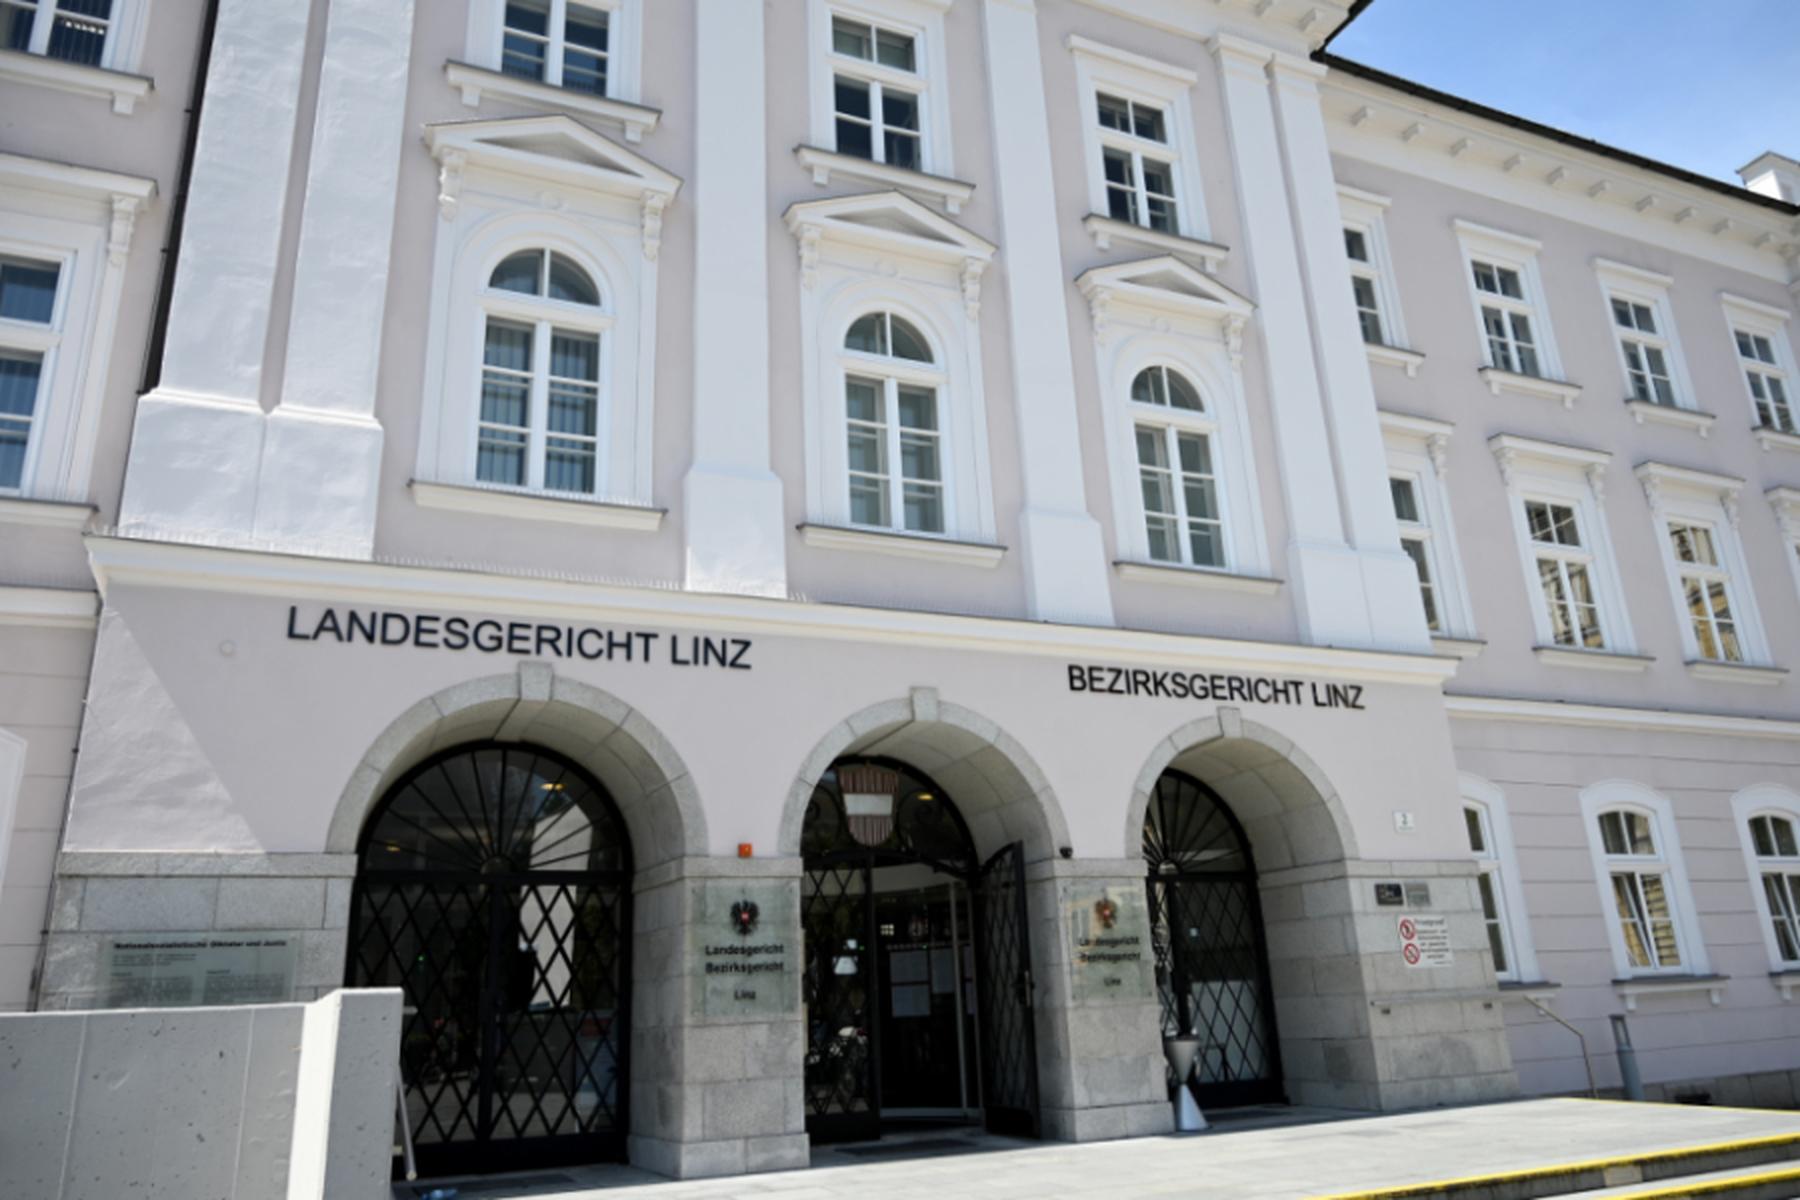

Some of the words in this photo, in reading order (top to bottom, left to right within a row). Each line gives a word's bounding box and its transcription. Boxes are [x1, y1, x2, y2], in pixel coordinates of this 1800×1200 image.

[287, 605, 659, 664] LANDESGERICHT
[670, 634, 752, 670] LINZ
[1067, 664, 1304, 705] BEZIRKSGERICHT
[1311, 682, 1366, 710] LINZ
[705, 944, 784, 957] Landesgericht
[705, 961, 784, 976] Bezirksgericht
[733, 989, 757, 1001] Linz
